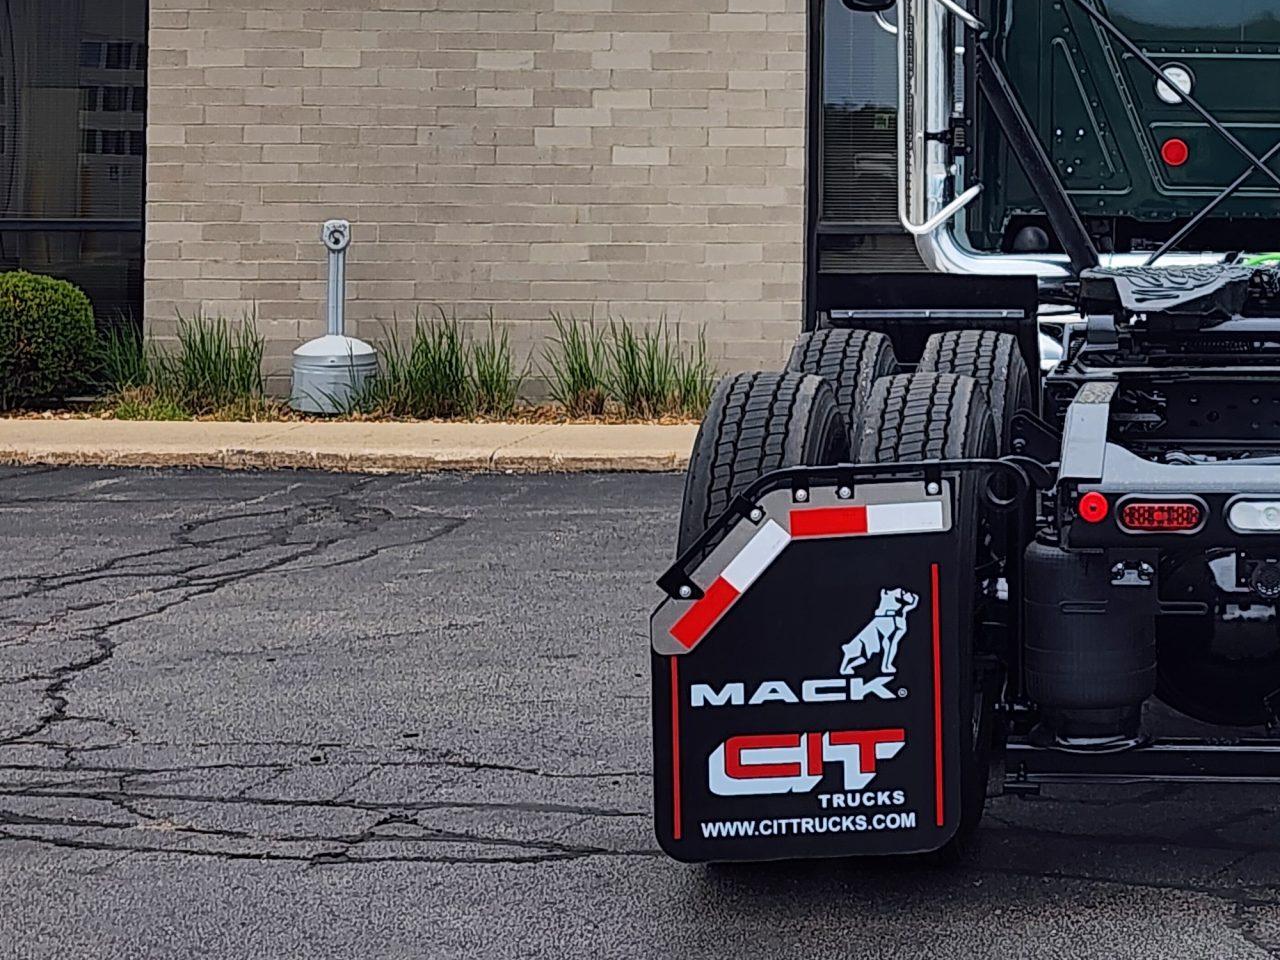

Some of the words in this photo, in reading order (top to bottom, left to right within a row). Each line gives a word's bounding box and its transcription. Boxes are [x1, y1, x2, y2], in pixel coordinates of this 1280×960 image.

[708, 728, 906, 796] CIT
[818, 790, 905, 809] TRUCKS
[701, 812, 916, 838] WWW.CITTRUCKS.COM
